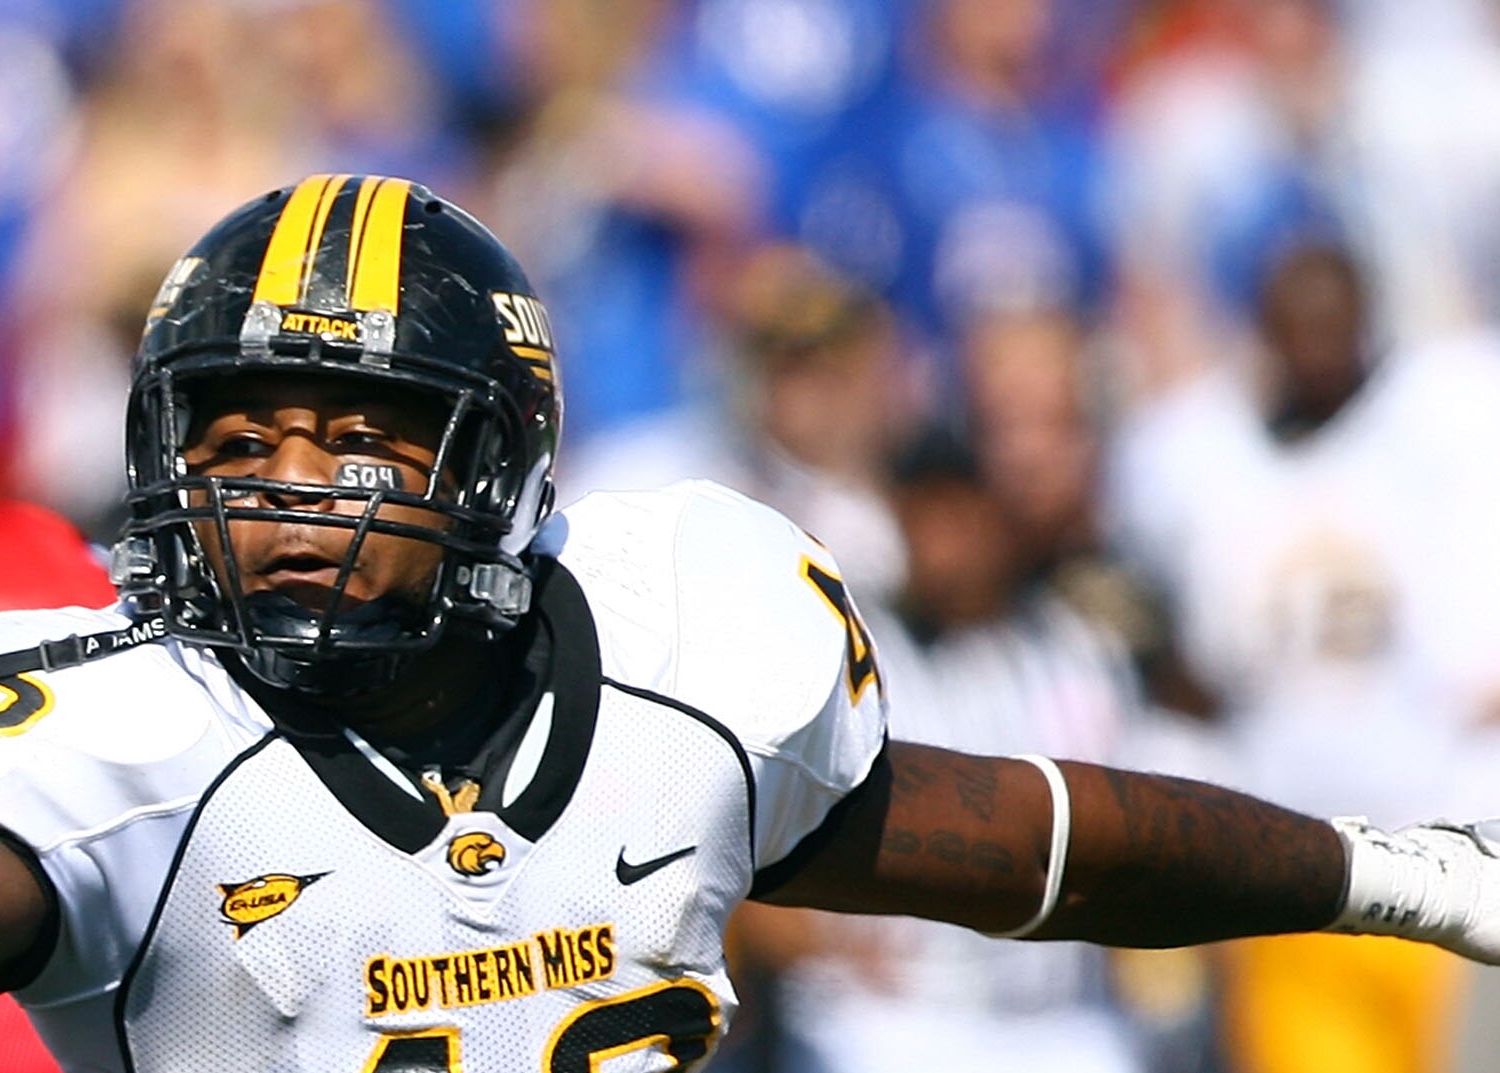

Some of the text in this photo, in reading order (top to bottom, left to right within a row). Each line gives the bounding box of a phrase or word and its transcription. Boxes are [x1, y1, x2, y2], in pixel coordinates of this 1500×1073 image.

[282, 313, 357, 341] ATTACK
[364, 921, 620, 1019] SOUTHERN MISS
